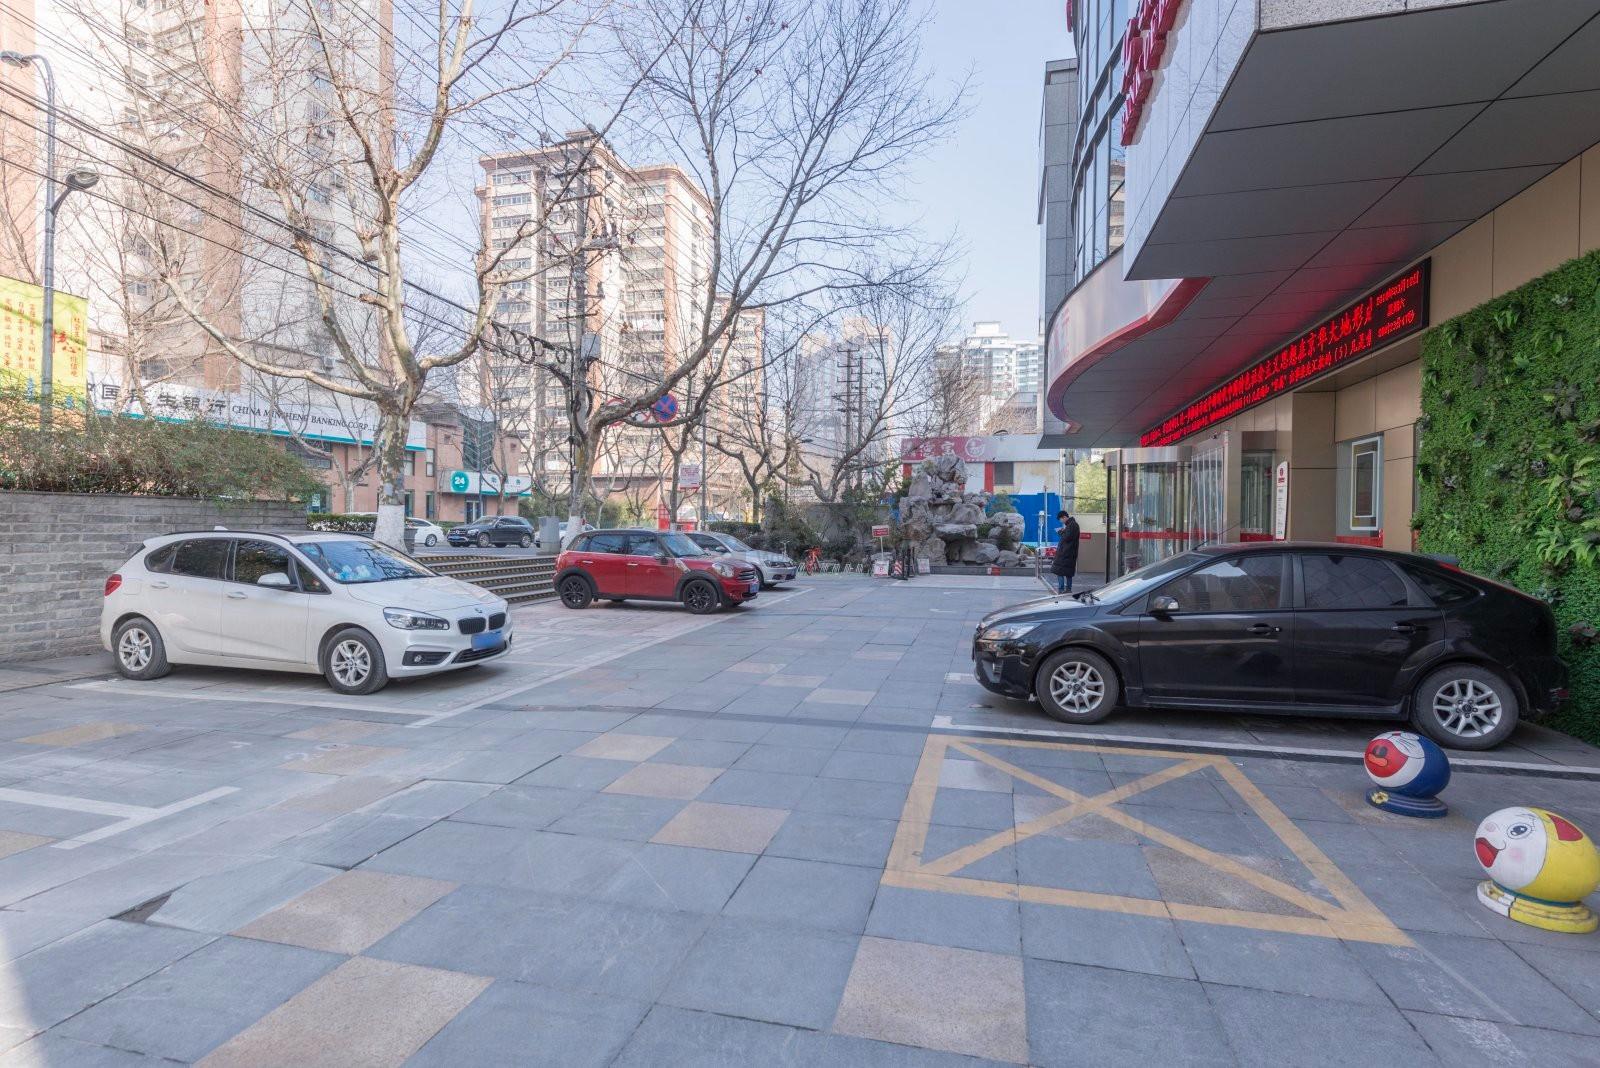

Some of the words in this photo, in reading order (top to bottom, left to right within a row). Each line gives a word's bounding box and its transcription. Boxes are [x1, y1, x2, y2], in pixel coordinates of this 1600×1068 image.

[232, 405, 261, 417] CHINA
[263, 409, 308, 422] MINHENG
[311, 415, 347, 428] BANKING
[454, 476, 466, 486] 24
